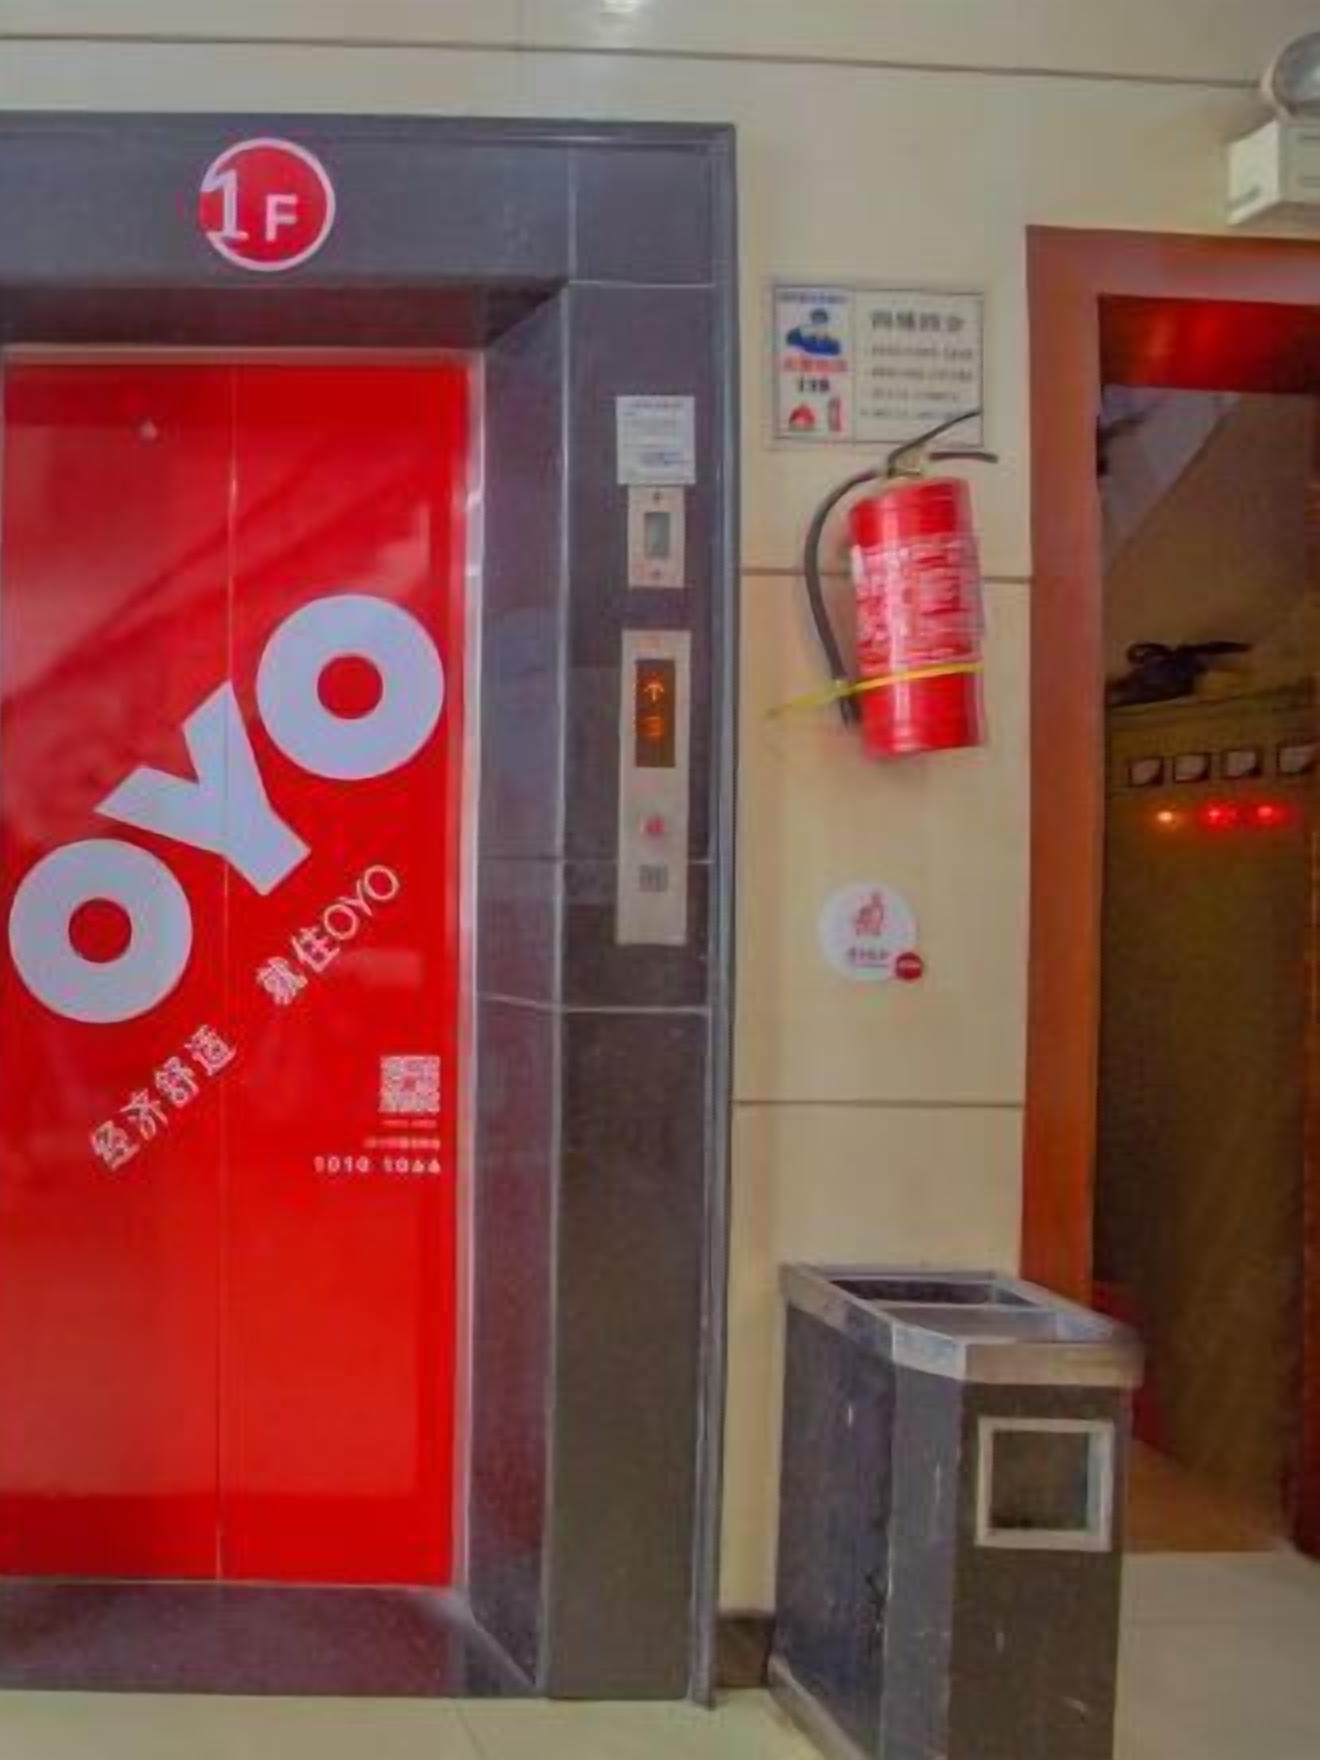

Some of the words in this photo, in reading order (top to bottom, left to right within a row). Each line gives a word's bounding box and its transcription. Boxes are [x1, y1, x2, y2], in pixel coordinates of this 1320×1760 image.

[8, 593, 445, 1024] OYO
[90, 1024, 236, 1170] 经济舒适
[256, 865, 400, 1006] 就住OYO
